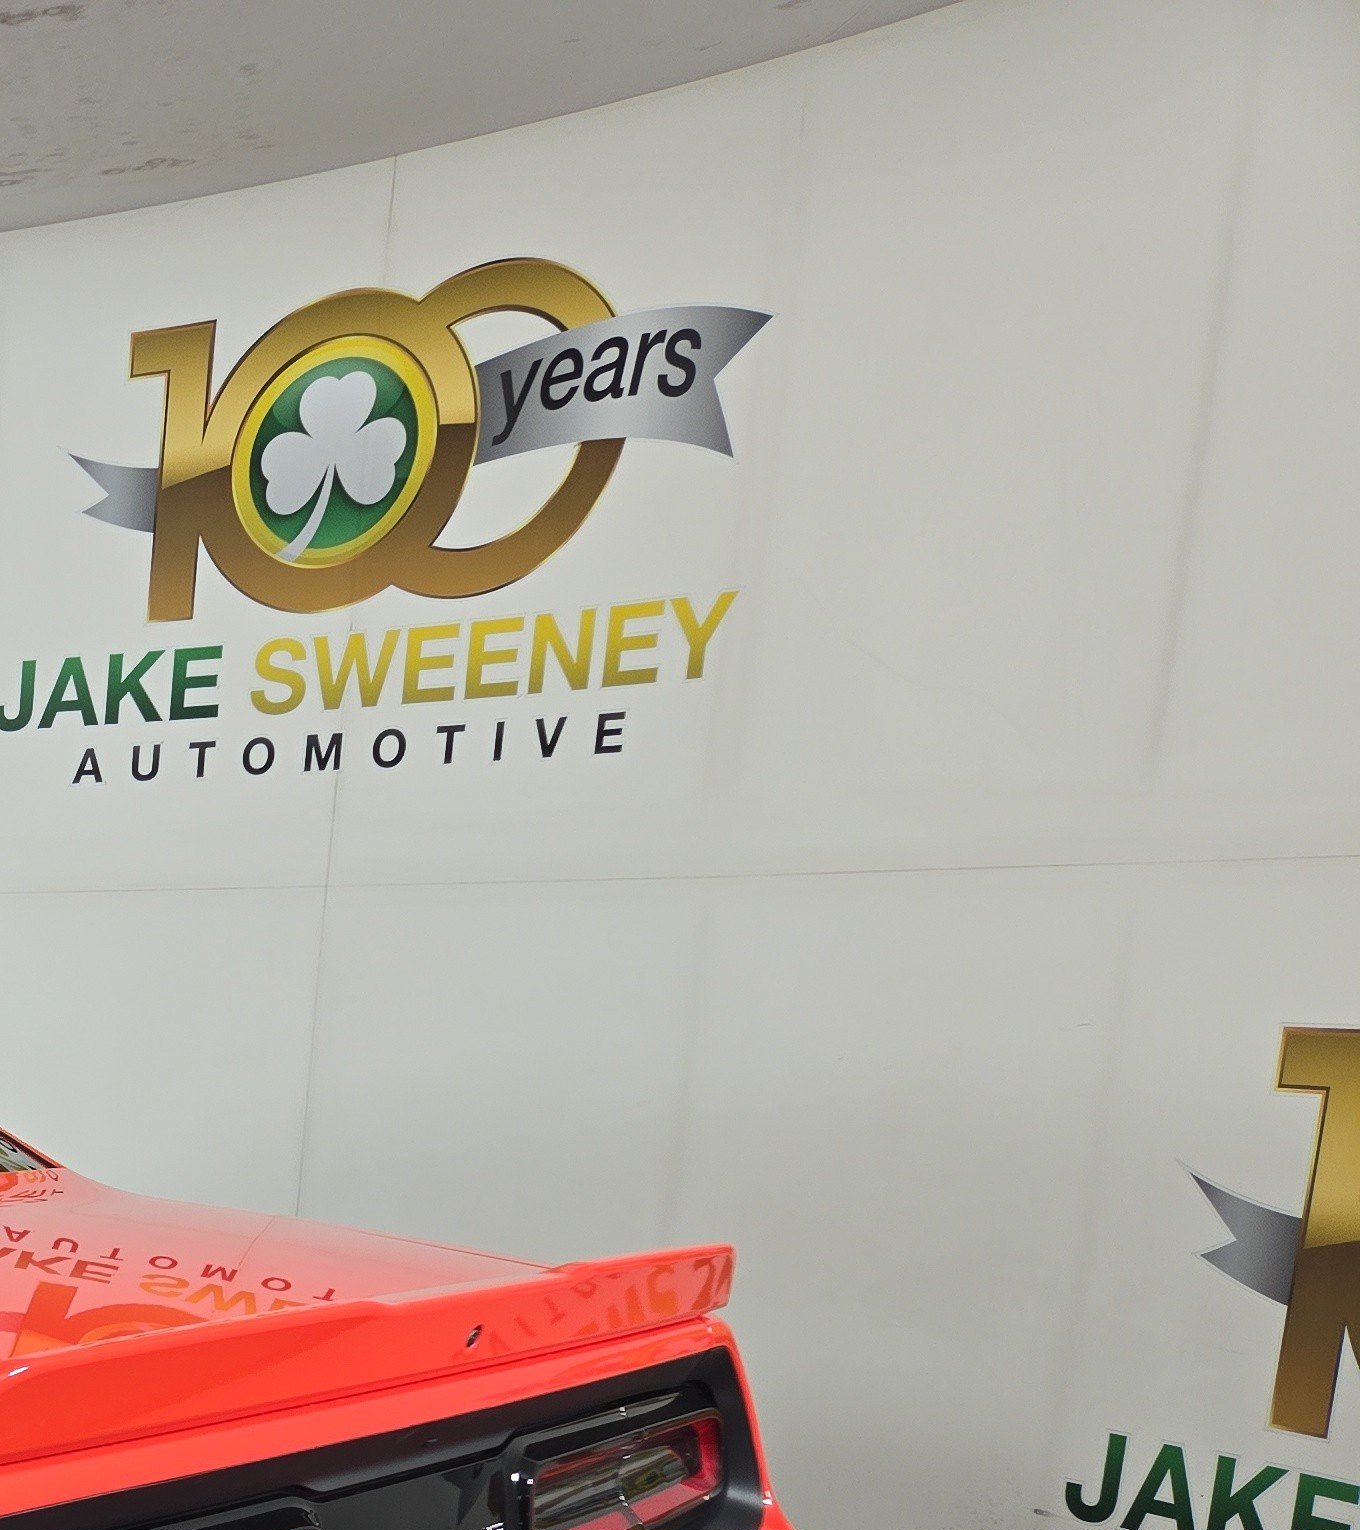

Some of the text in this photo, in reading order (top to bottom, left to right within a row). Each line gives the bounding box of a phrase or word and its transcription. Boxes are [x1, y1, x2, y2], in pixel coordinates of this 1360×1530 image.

[129, 256, 628, 623] 100
[491, 326, 703, 447] years
[249, 589, 740, 716] SWEENEY
[71, 710, 627, 786] AUTOMOTIVE
